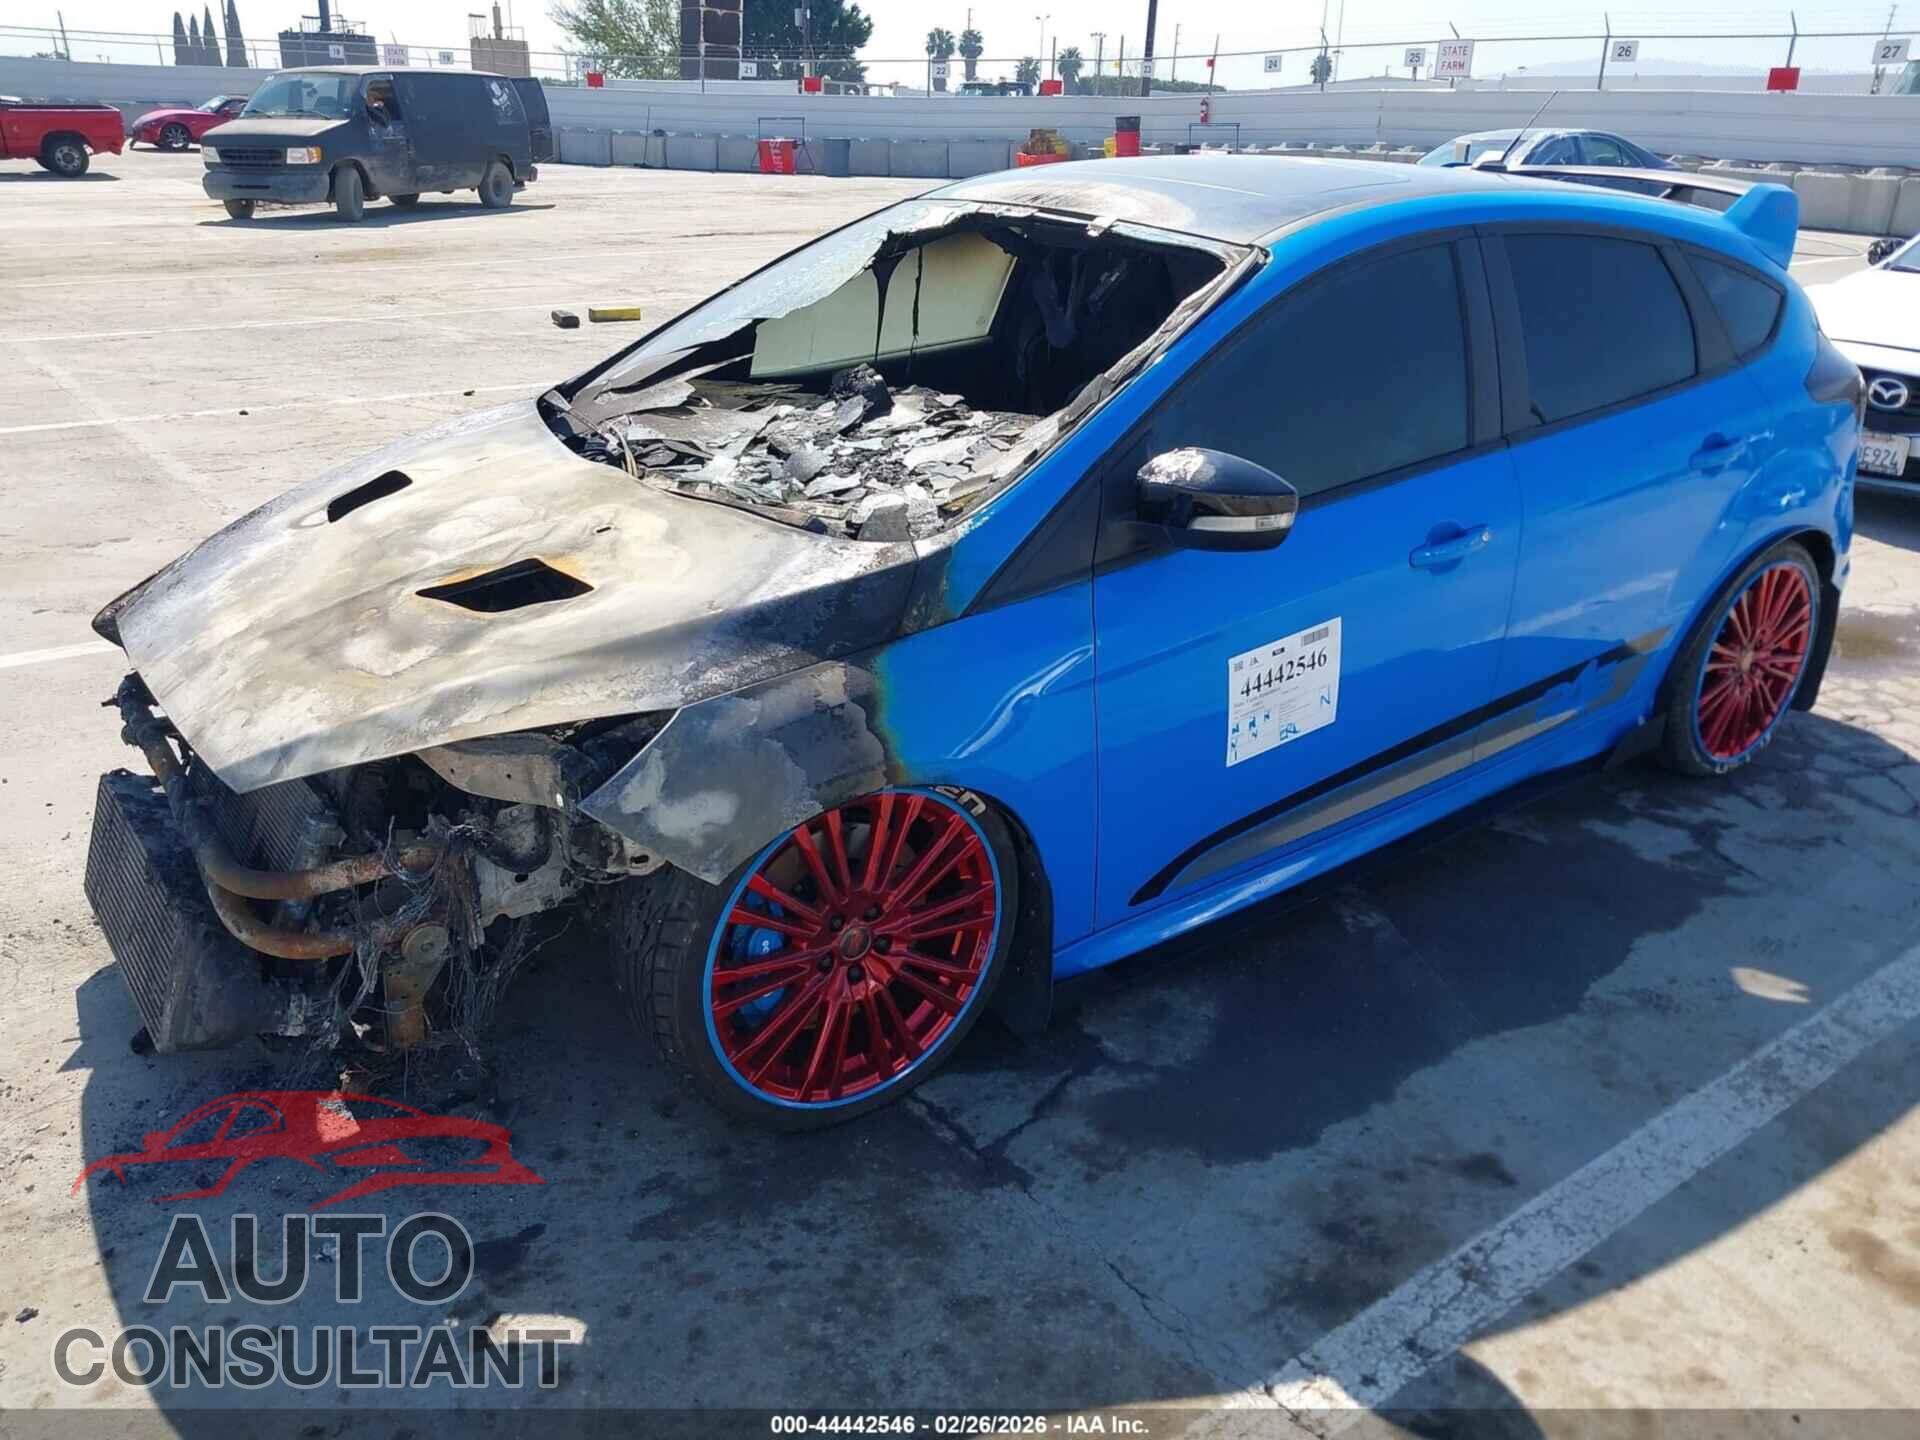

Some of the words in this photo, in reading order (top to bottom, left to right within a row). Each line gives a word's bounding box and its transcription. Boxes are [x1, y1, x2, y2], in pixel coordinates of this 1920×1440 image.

[387, 47, 405, 56] STATE
[1441, 46, 1468, 56] STATE
[1617, 46, 1632, 56] 26
[1881, 45, 1901, 58] 27
[387, 57, 405, 65] FARM
[1409, 52, 1421, 63] 25
[581, 61, 591, 69] 20
[1268, 59, 1278, 69] 24
[1441, 61, 1465, 71] FARM
[744, 65, 753, 74] 21
[936, 66, 946, 75] 22
[1240, 647, 1327, 697] 44442546
